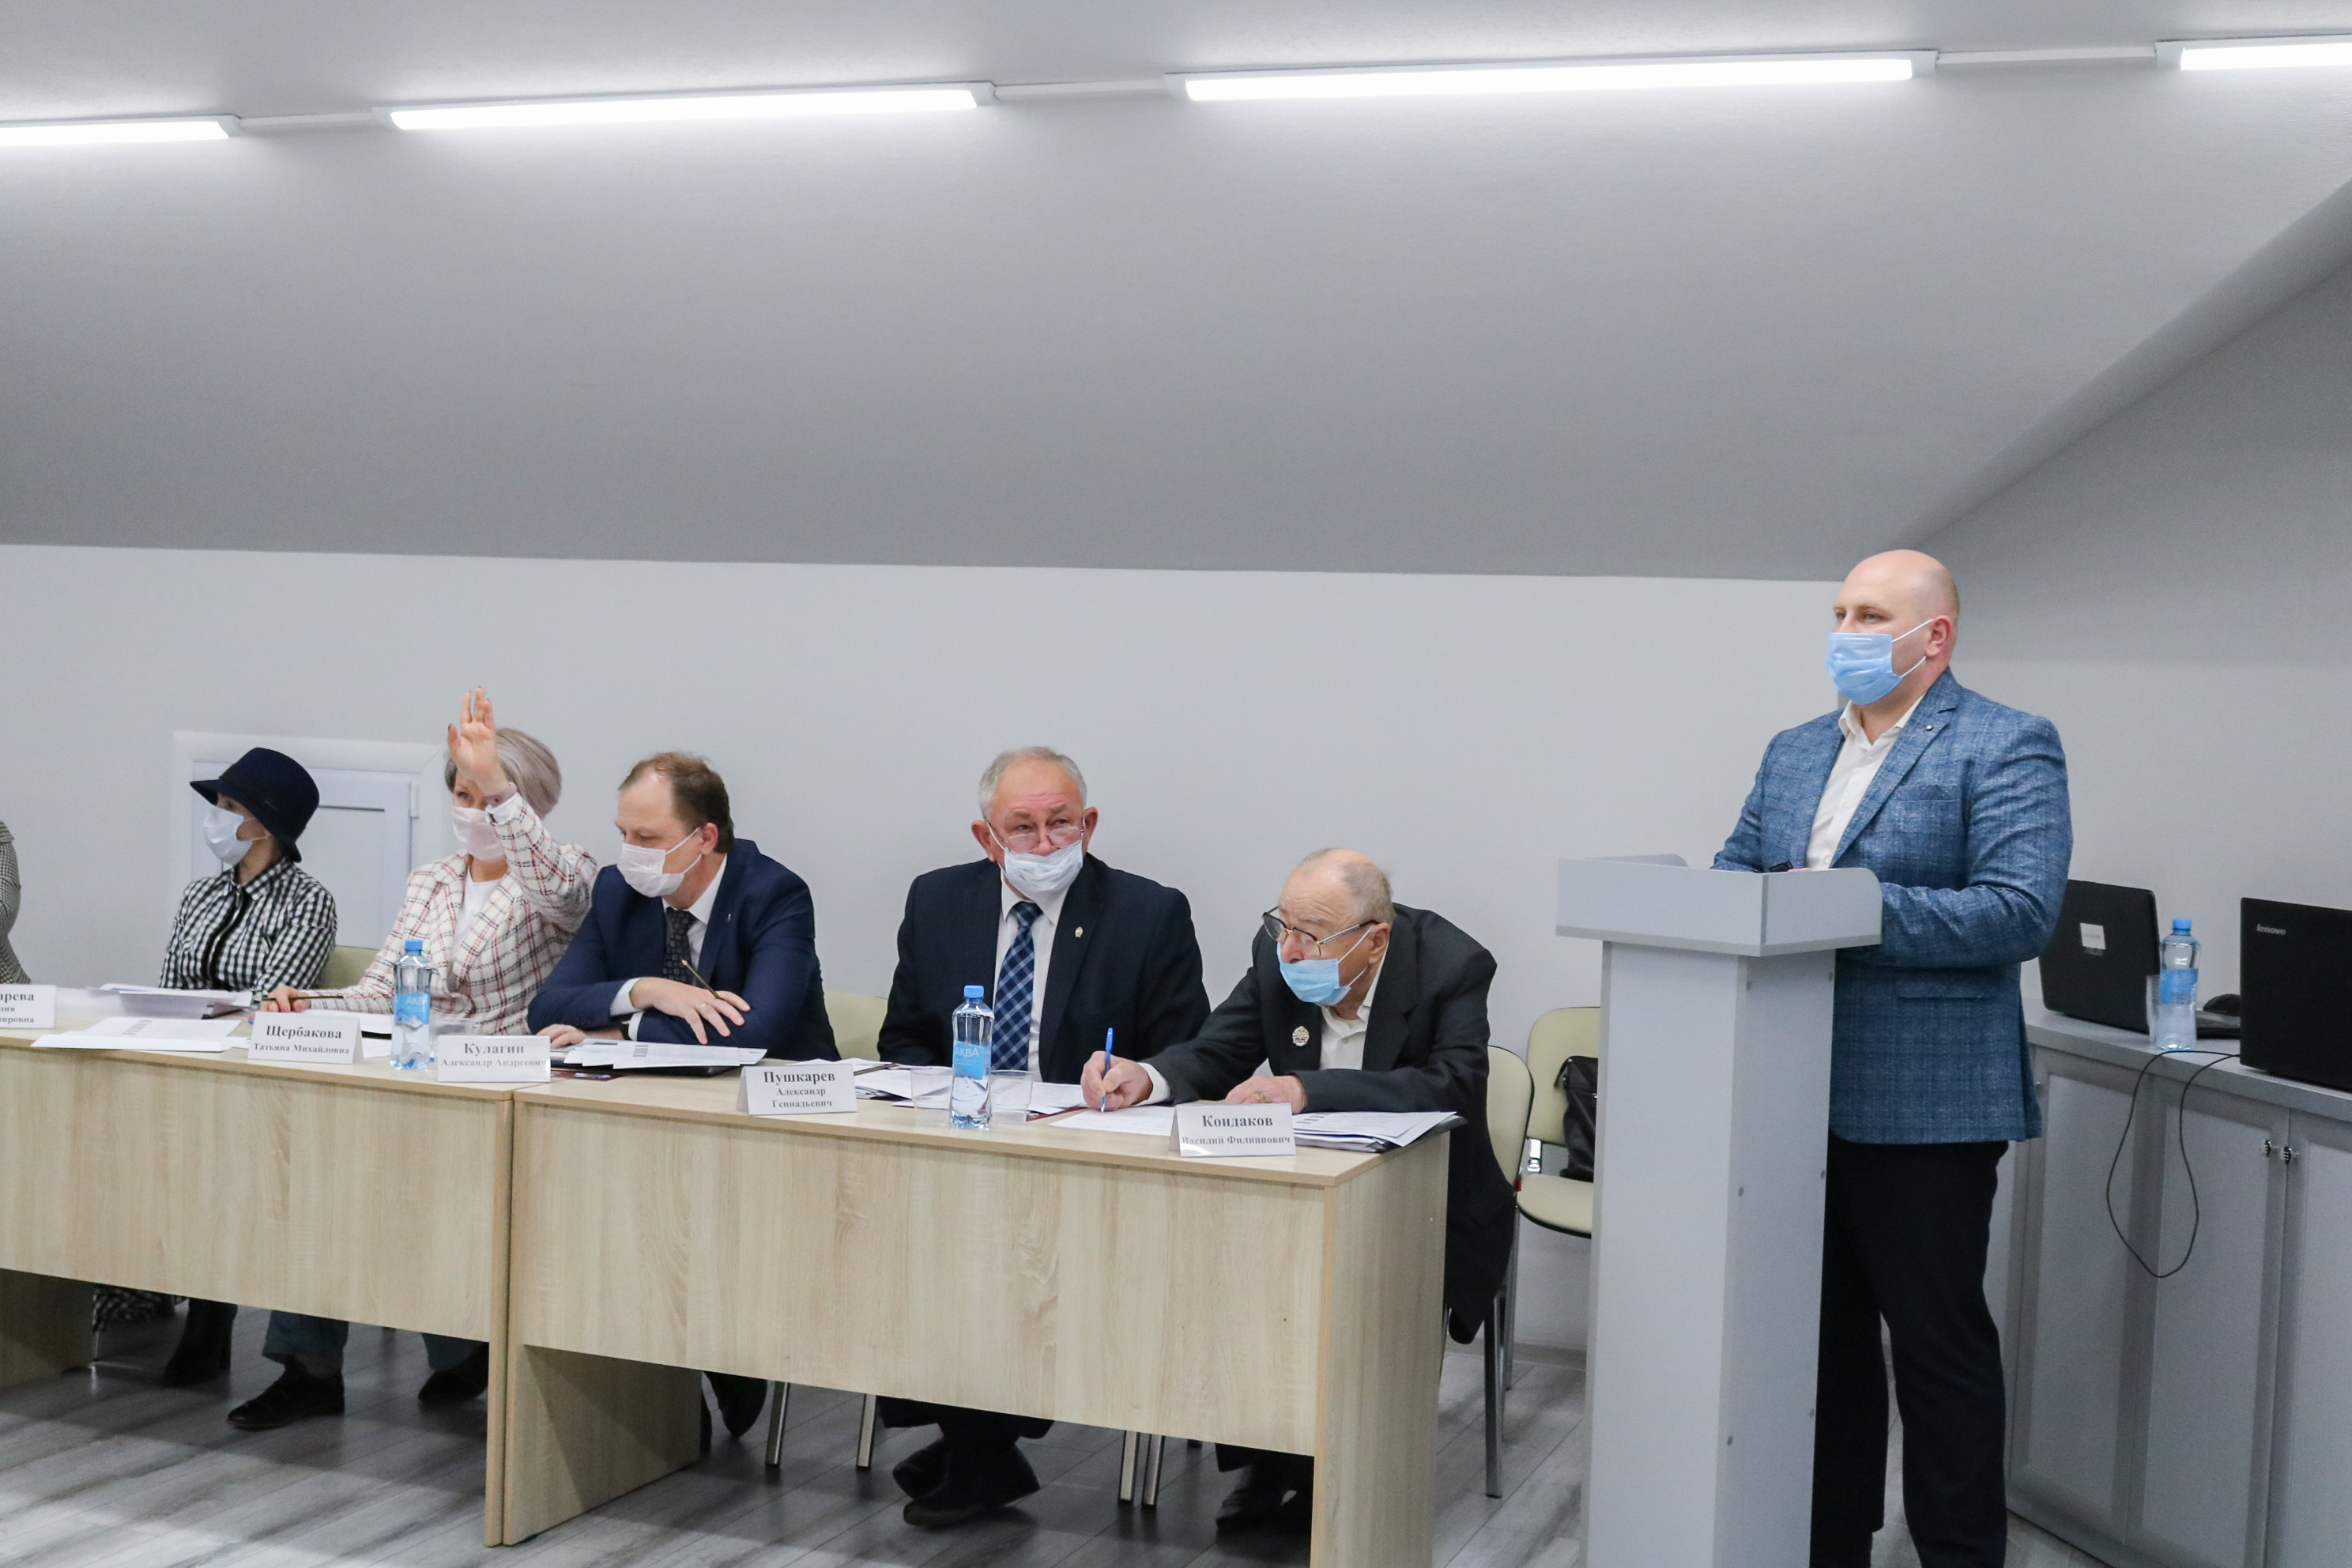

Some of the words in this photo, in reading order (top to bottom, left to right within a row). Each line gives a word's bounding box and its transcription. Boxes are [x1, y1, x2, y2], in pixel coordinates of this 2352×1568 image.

[2256, 923, 2286, 935] lenovo
[266, 1025, 341, 1039] Щербакова
[254, 1042, 290, 1052] Татьяна
[293, 1044, 349, 1054] Михайловна
[464, 1042, 525, 1057] Кулагин
[955, 1046, 979, 1058] АКВА
[441, 1059, 492, 1068] Александр
[763, 1071, 835, 1085] Пушкарев
[776, 1087, 826, 1097] Александр
[772, 1099, 832, 1108] Геннадьевич
[1202, 1114, 1273, 1128] Кондаков
[1182, 1136, 1224, 1144] Василий
[1227, 1135, 1290, 1144] Филиппович
